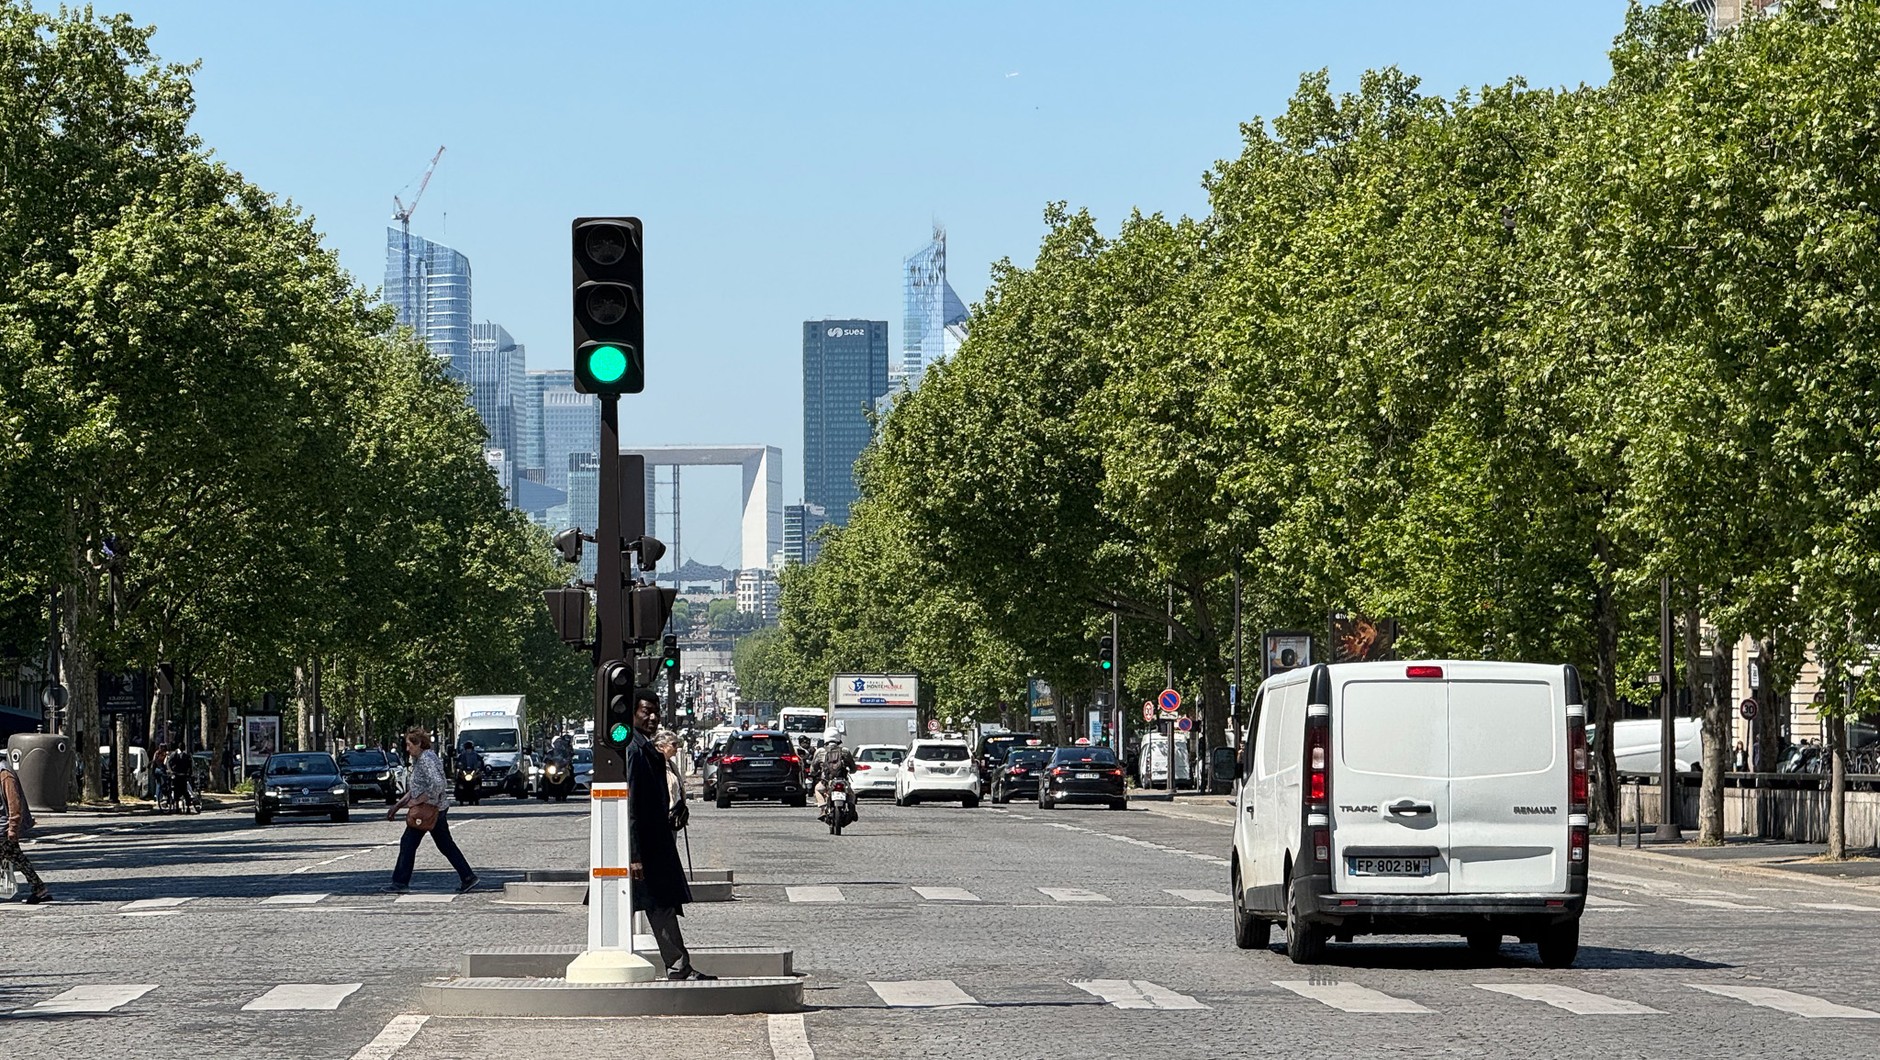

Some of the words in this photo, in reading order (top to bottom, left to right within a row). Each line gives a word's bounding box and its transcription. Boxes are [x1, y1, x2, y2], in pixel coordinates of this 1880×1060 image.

[1744, 704, 1754, 714] 30
[1339, 805, 1378, 813] TRAFIC
[1513, 806, 1557, 815] RENAULT
